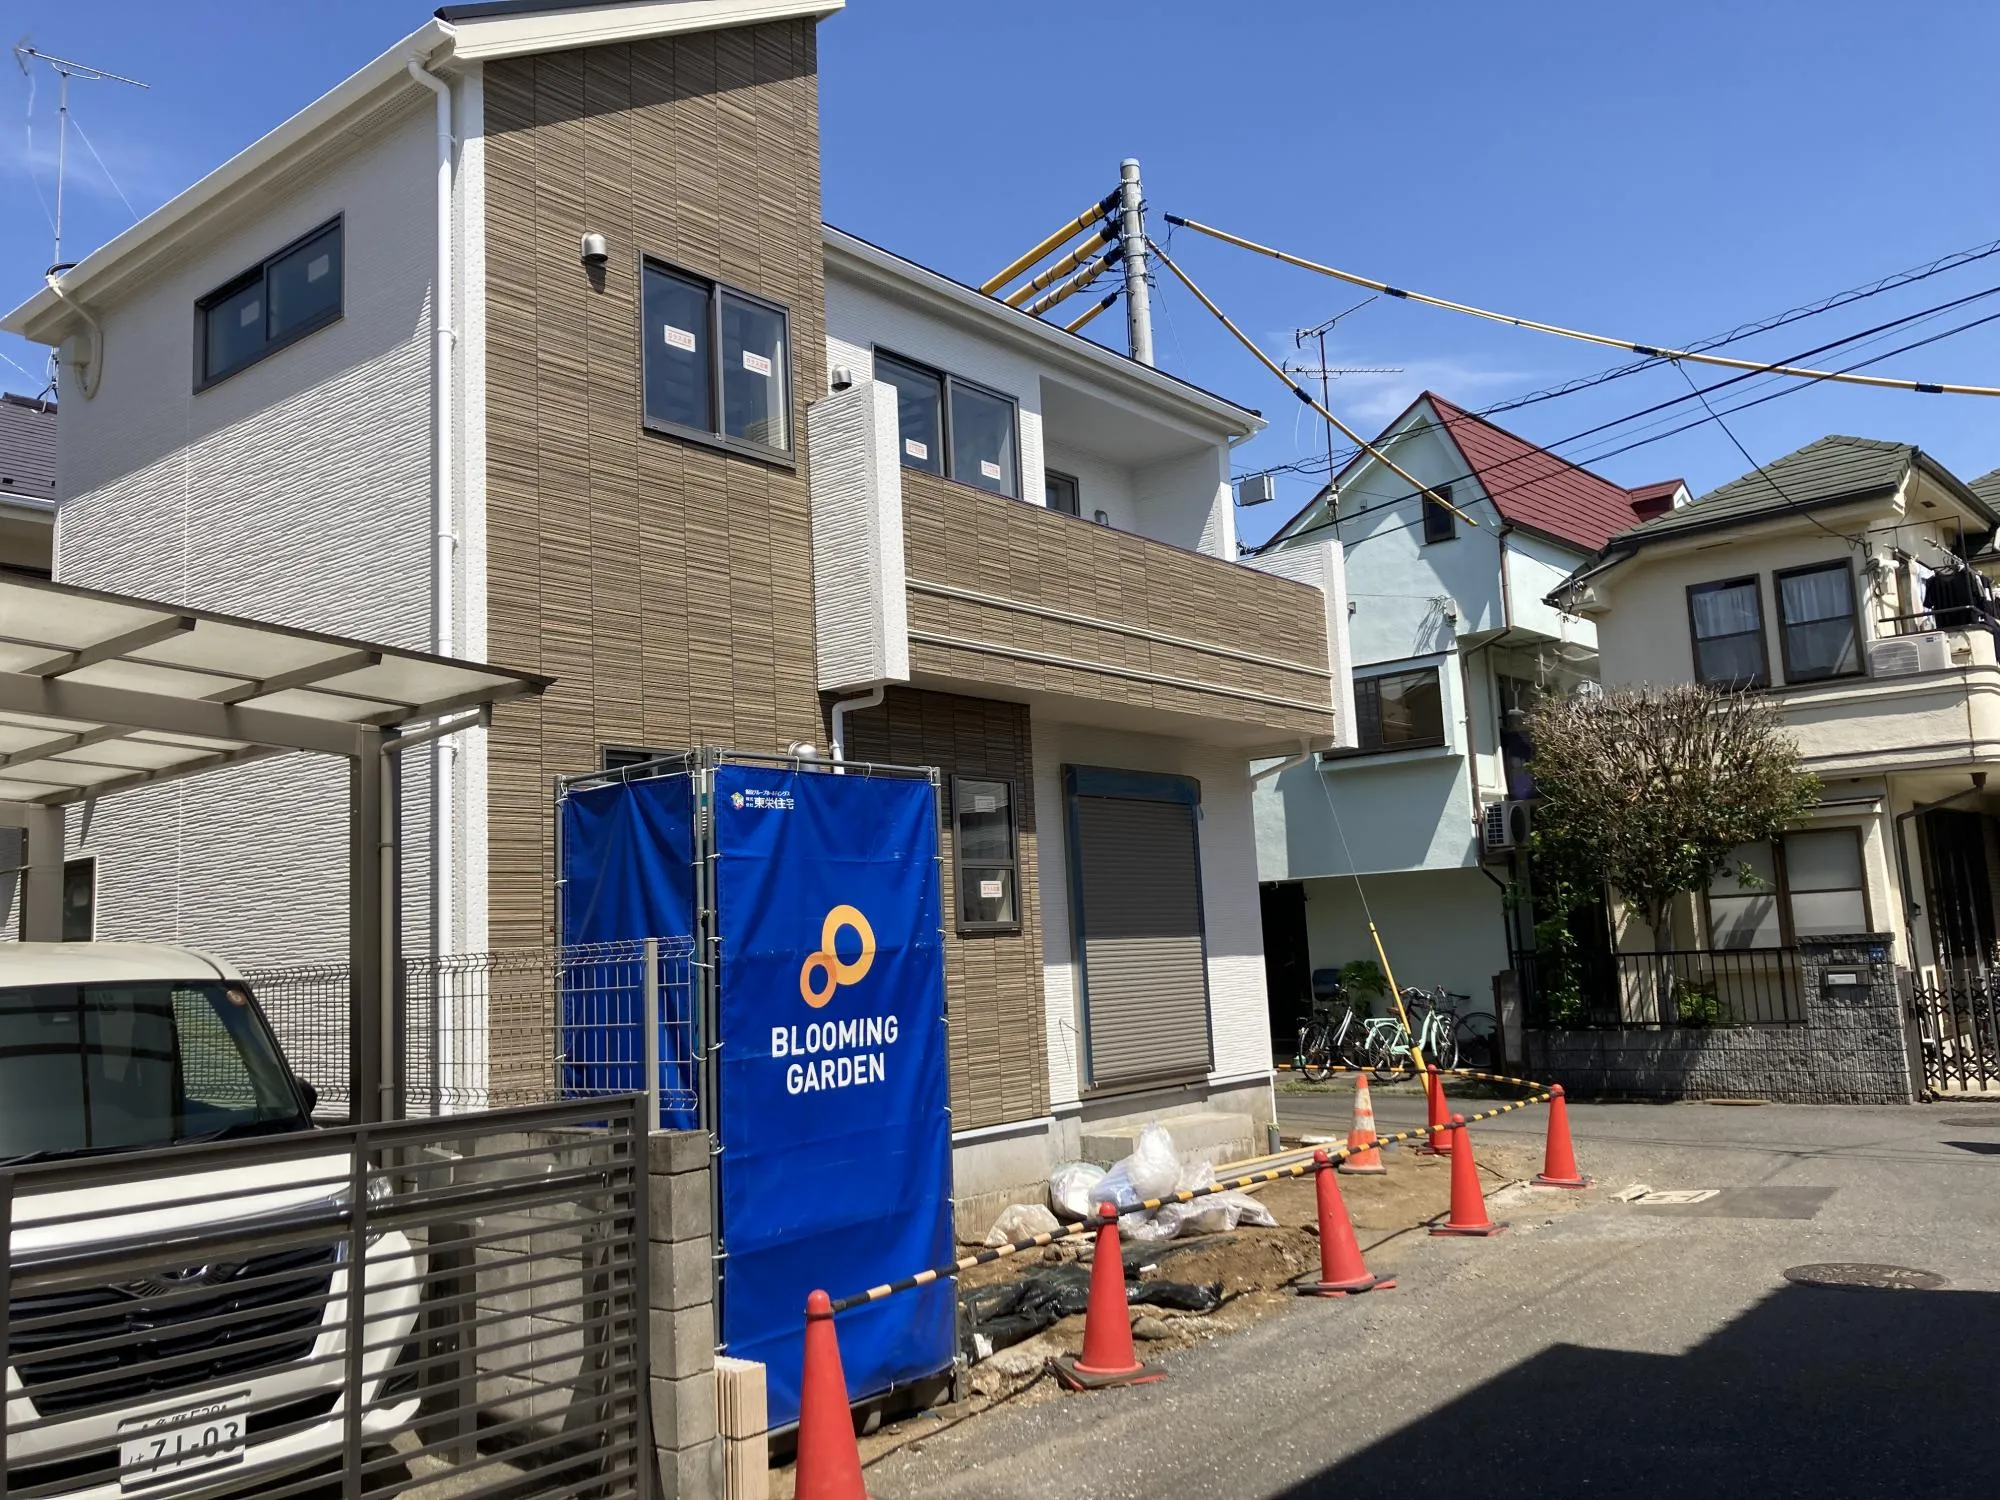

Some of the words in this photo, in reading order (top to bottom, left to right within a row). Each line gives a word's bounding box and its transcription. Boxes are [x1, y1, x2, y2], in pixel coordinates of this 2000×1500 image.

[754, 796, 795, 810] 東栄住宅
[771, 1015, 899, 1058] BLOOMING
[786, 1052, 885, 1095] GARDEN
[150, 1421, 240, 1472] 71-03
